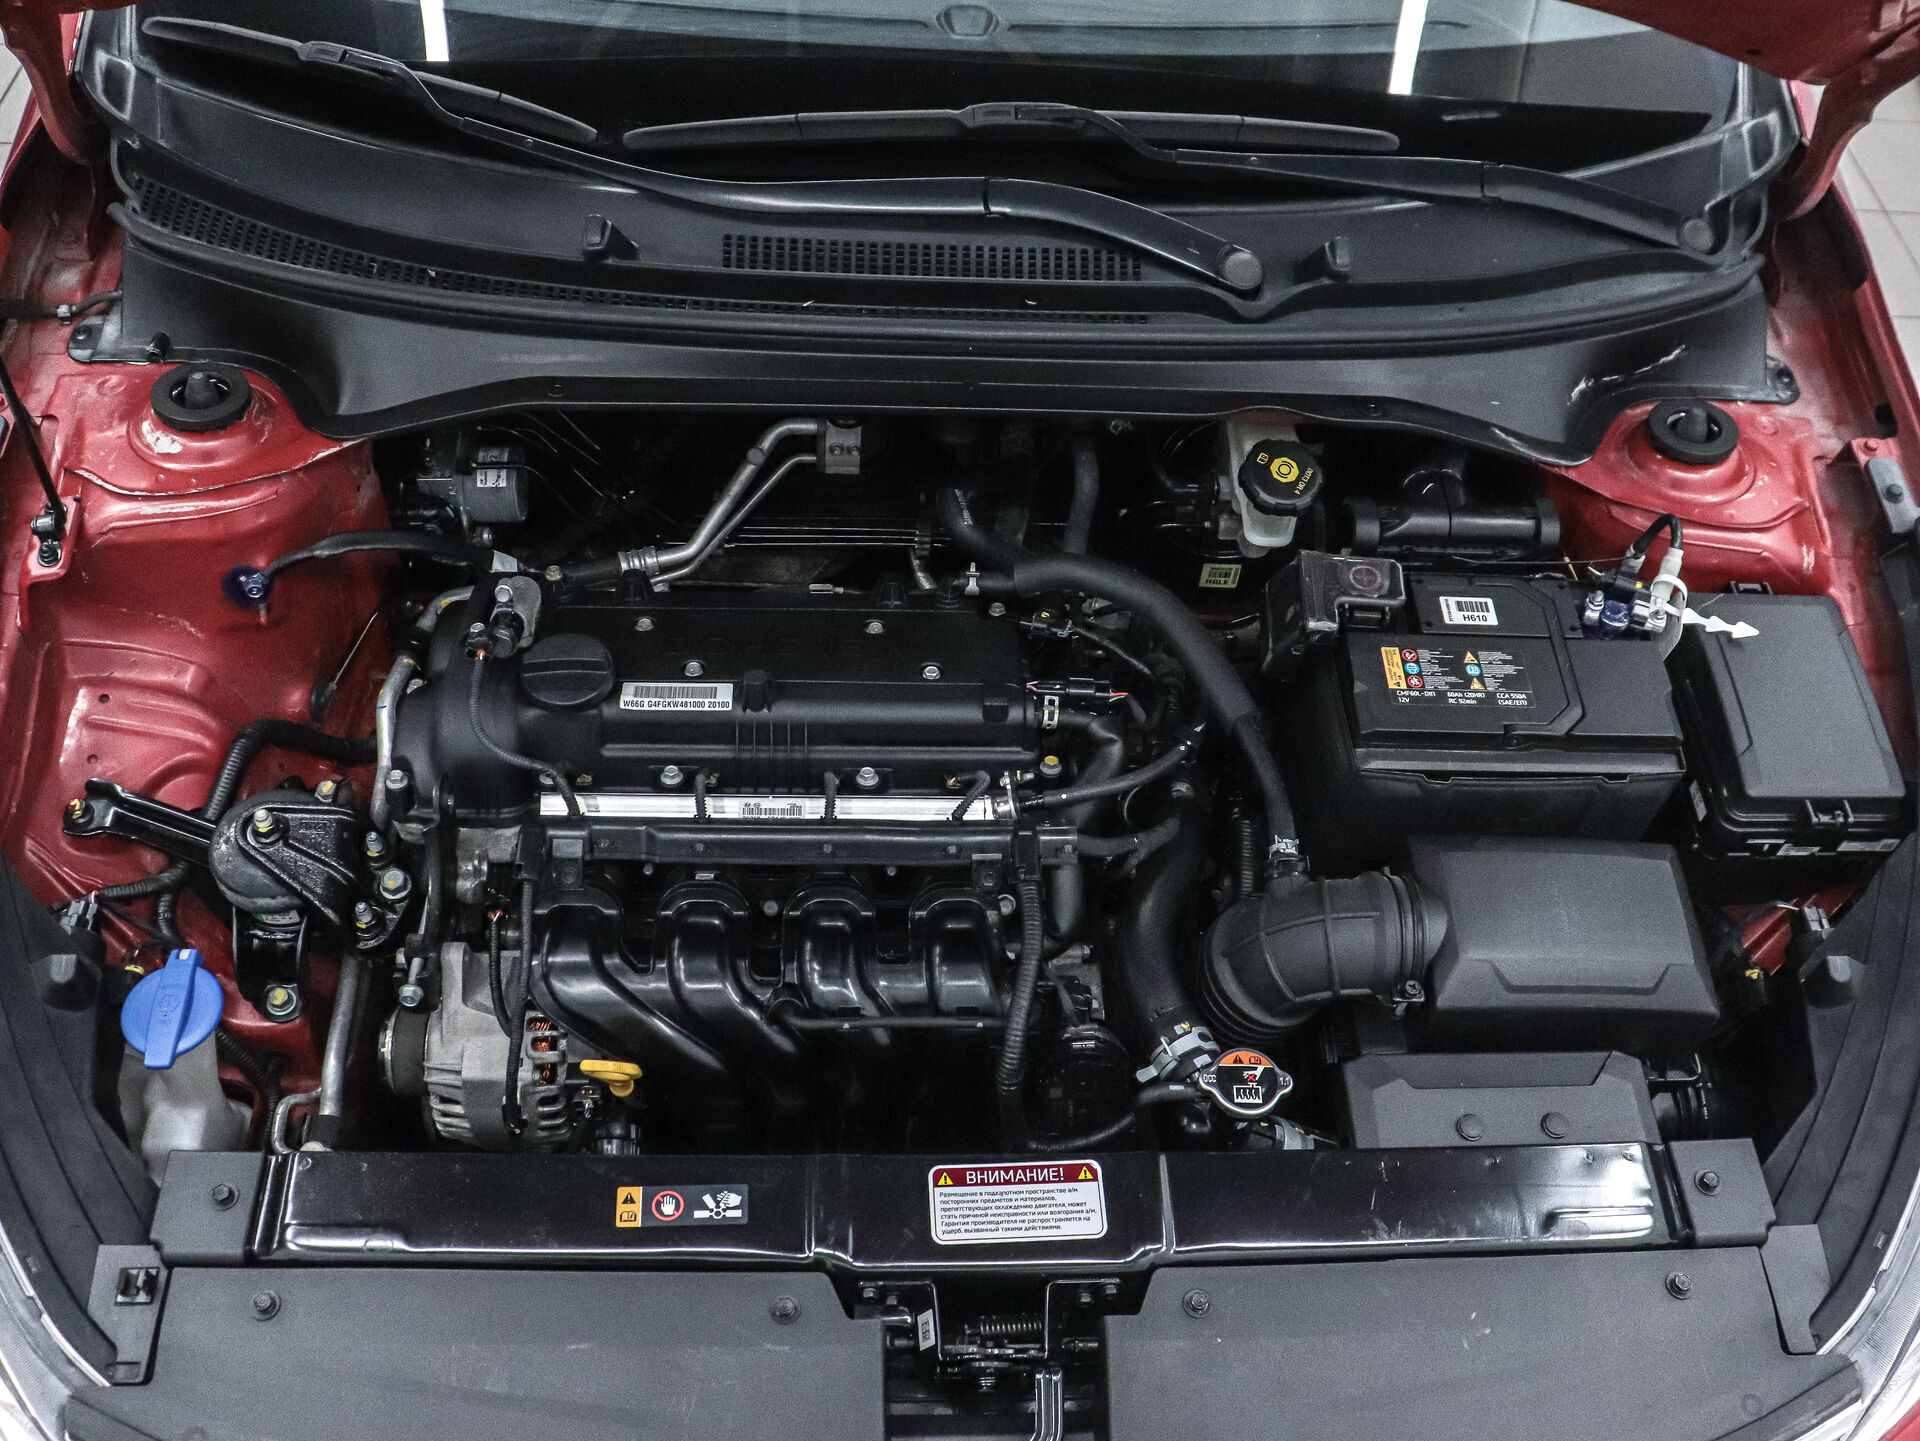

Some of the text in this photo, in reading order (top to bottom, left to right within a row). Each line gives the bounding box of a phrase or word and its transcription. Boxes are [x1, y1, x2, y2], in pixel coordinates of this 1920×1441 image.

[1463, 614, 1488, 622] H610
[623, 700, 730, 709] W66G G4FGKW481000 20100
[966, 1167, 1065, 1184] ВНИМАНИЕ!
[940, 1205, 993, 1213] препятствующих
